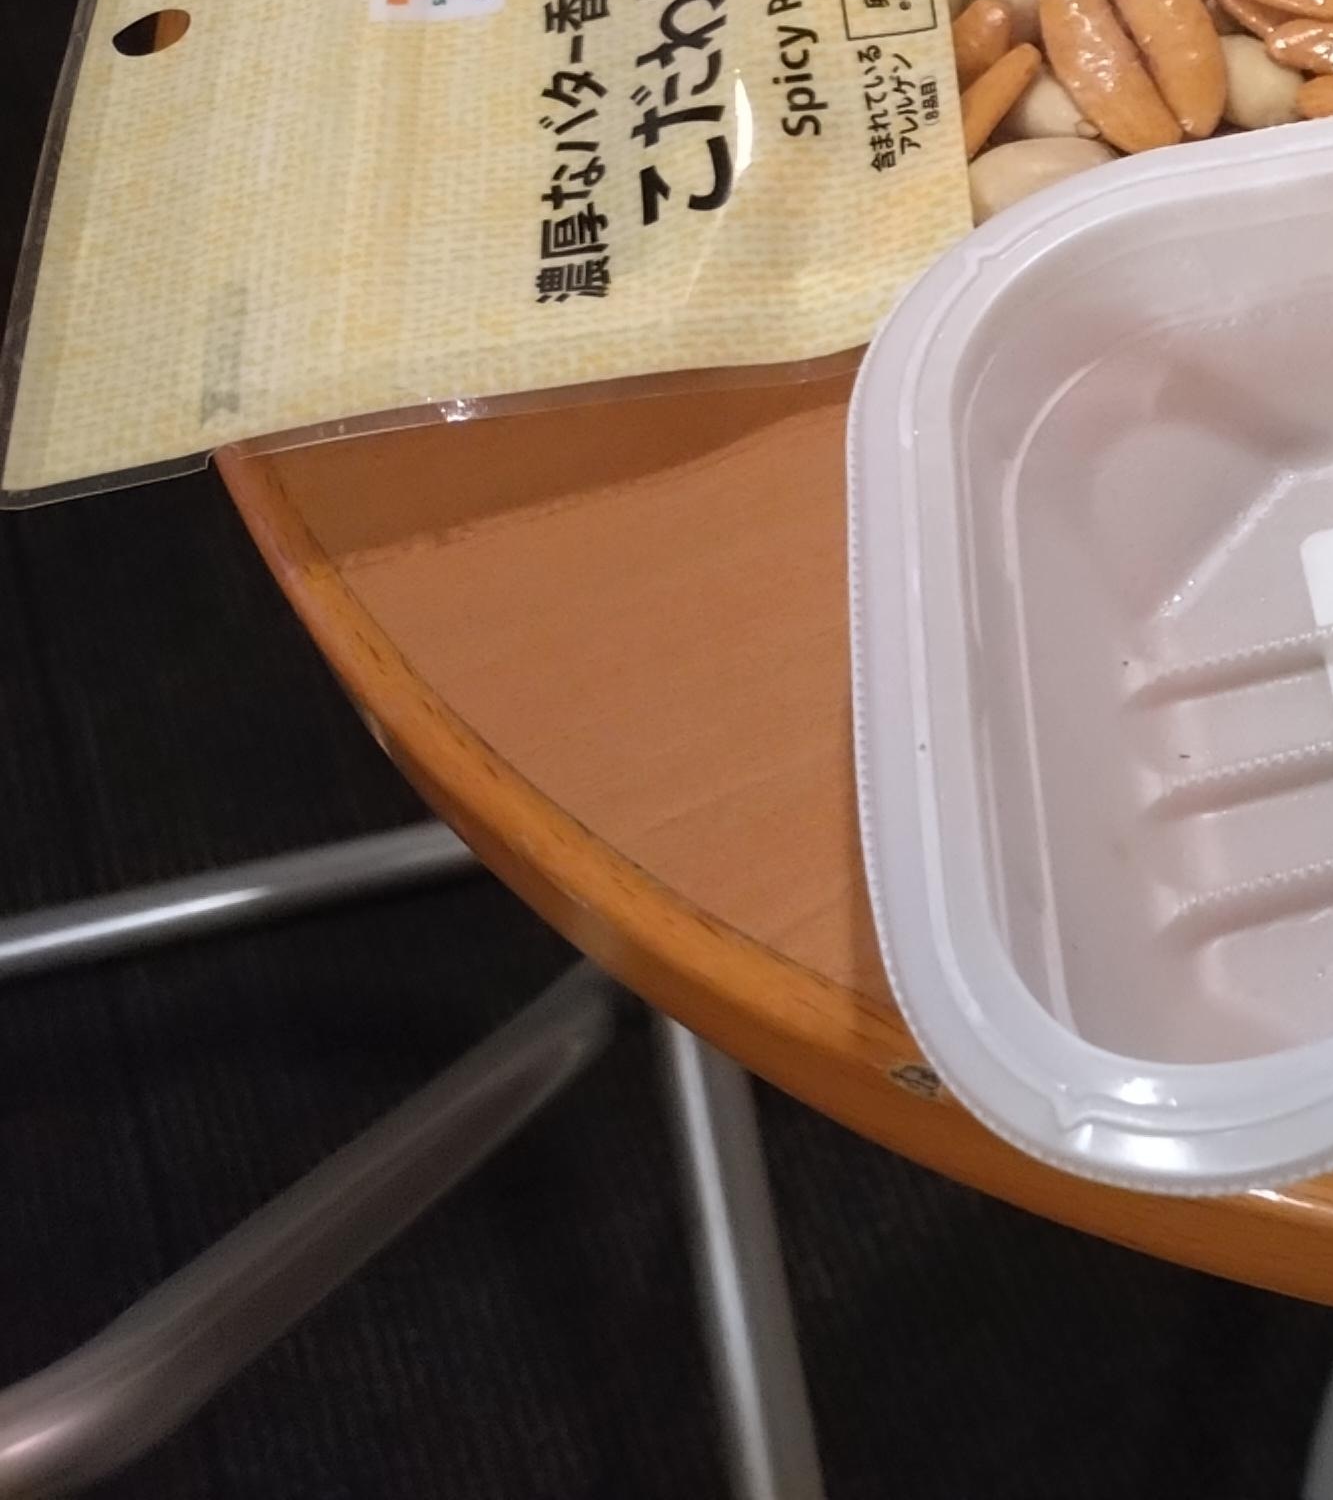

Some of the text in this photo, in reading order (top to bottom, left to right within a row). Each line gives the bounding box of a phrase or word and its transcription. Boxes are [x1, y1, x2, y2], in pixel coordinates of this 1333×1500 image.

[773, 24, 829, 138] Spicy
[856, 44, 895, 174] 含まれている
